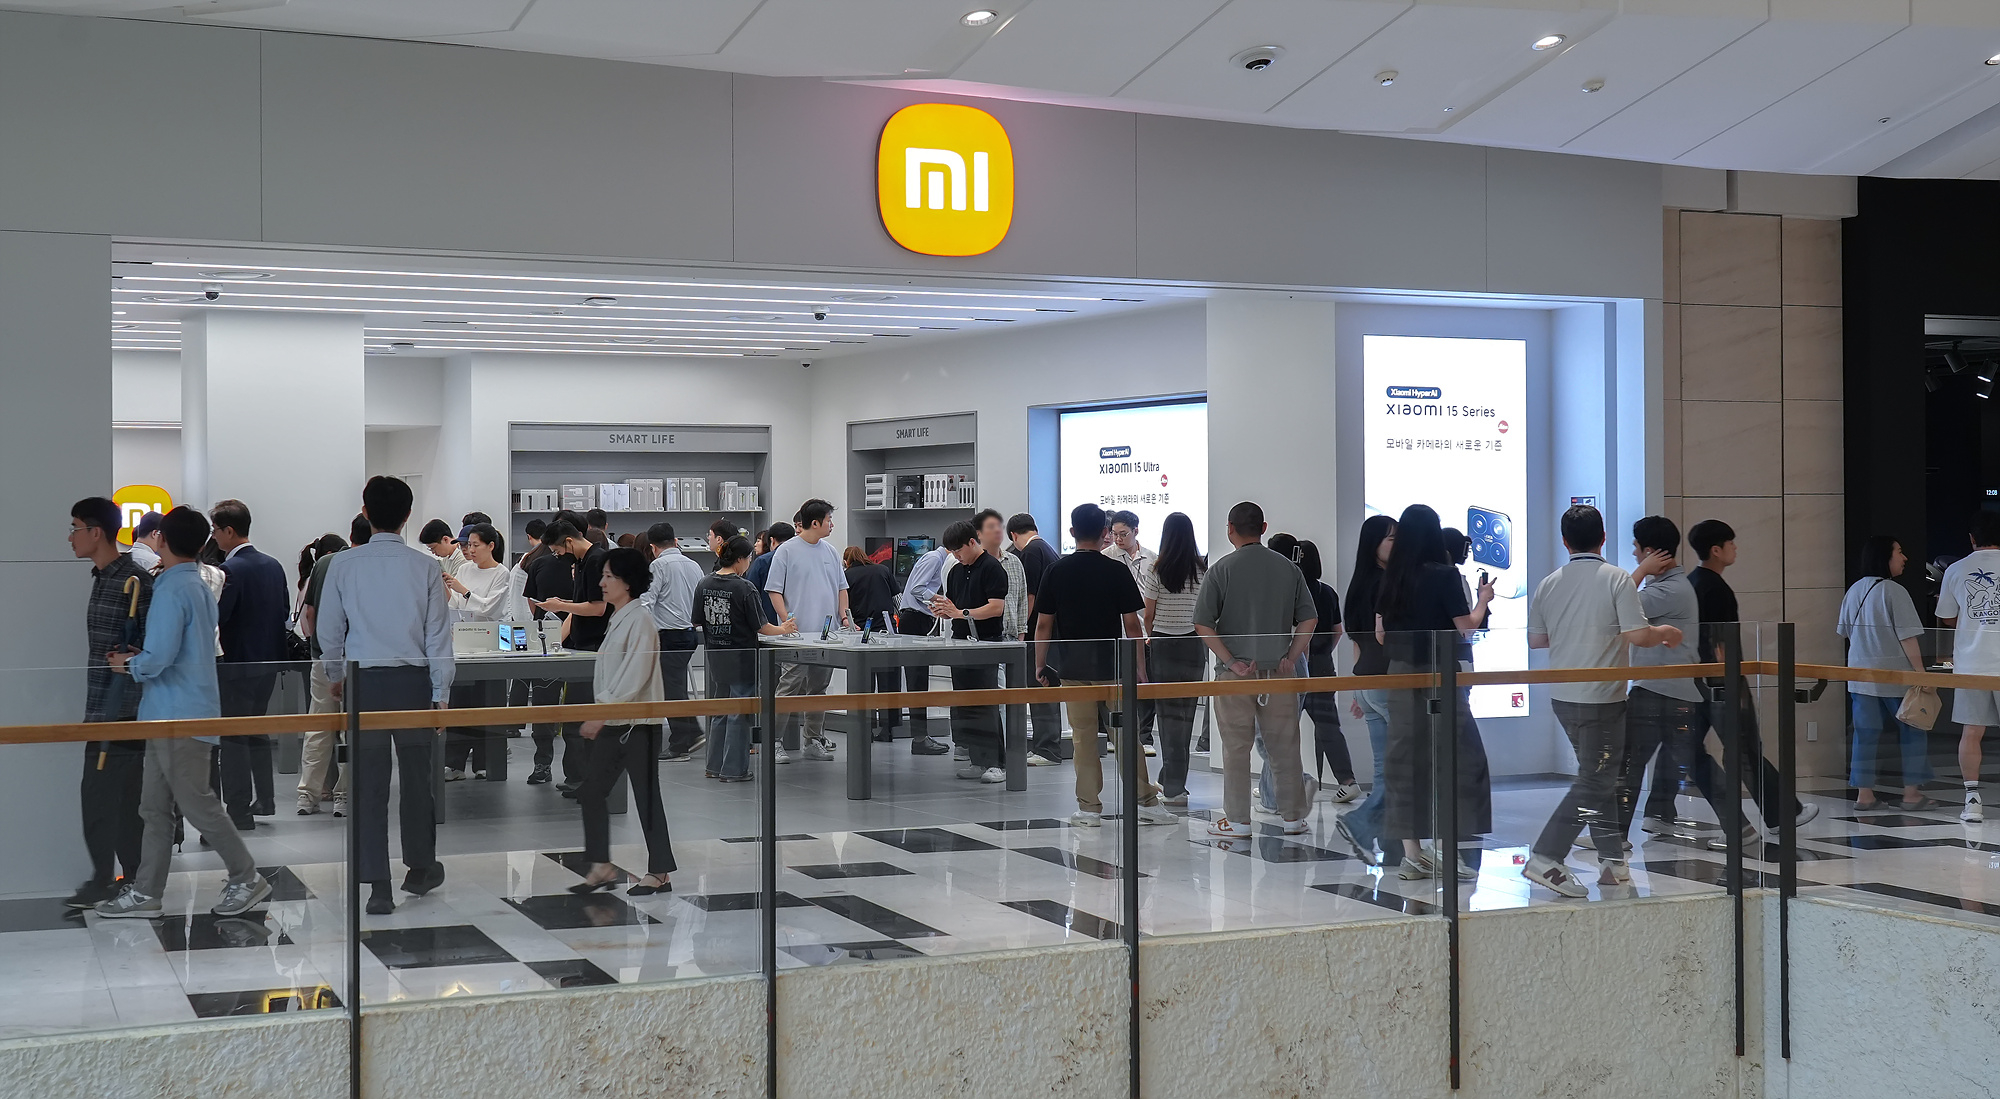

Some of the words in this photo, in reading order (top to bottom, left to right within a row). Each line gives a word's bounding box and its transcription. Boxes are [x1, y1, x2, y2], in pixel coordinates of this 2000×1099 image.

[1446, 405, 1458, 417] 15
[1462, 405, 1496, 418] Series
[609, 434, 648, 444] SMART
[651, 434, 675, 444] LIFE
[896, 428, 916, 439] SMART
[916, 427, 929, 438] LIFE
[1386, 438, 1413, 450] 모바일
[1416, 439, 1452, 450] 카메라의
[1456, 439, 1481, 451] 새로운
[1485, 440, 1503, 451] 기준
[1134, 462, 1142, 473] 15
[1143, 462, 1160, 473] Ultra
